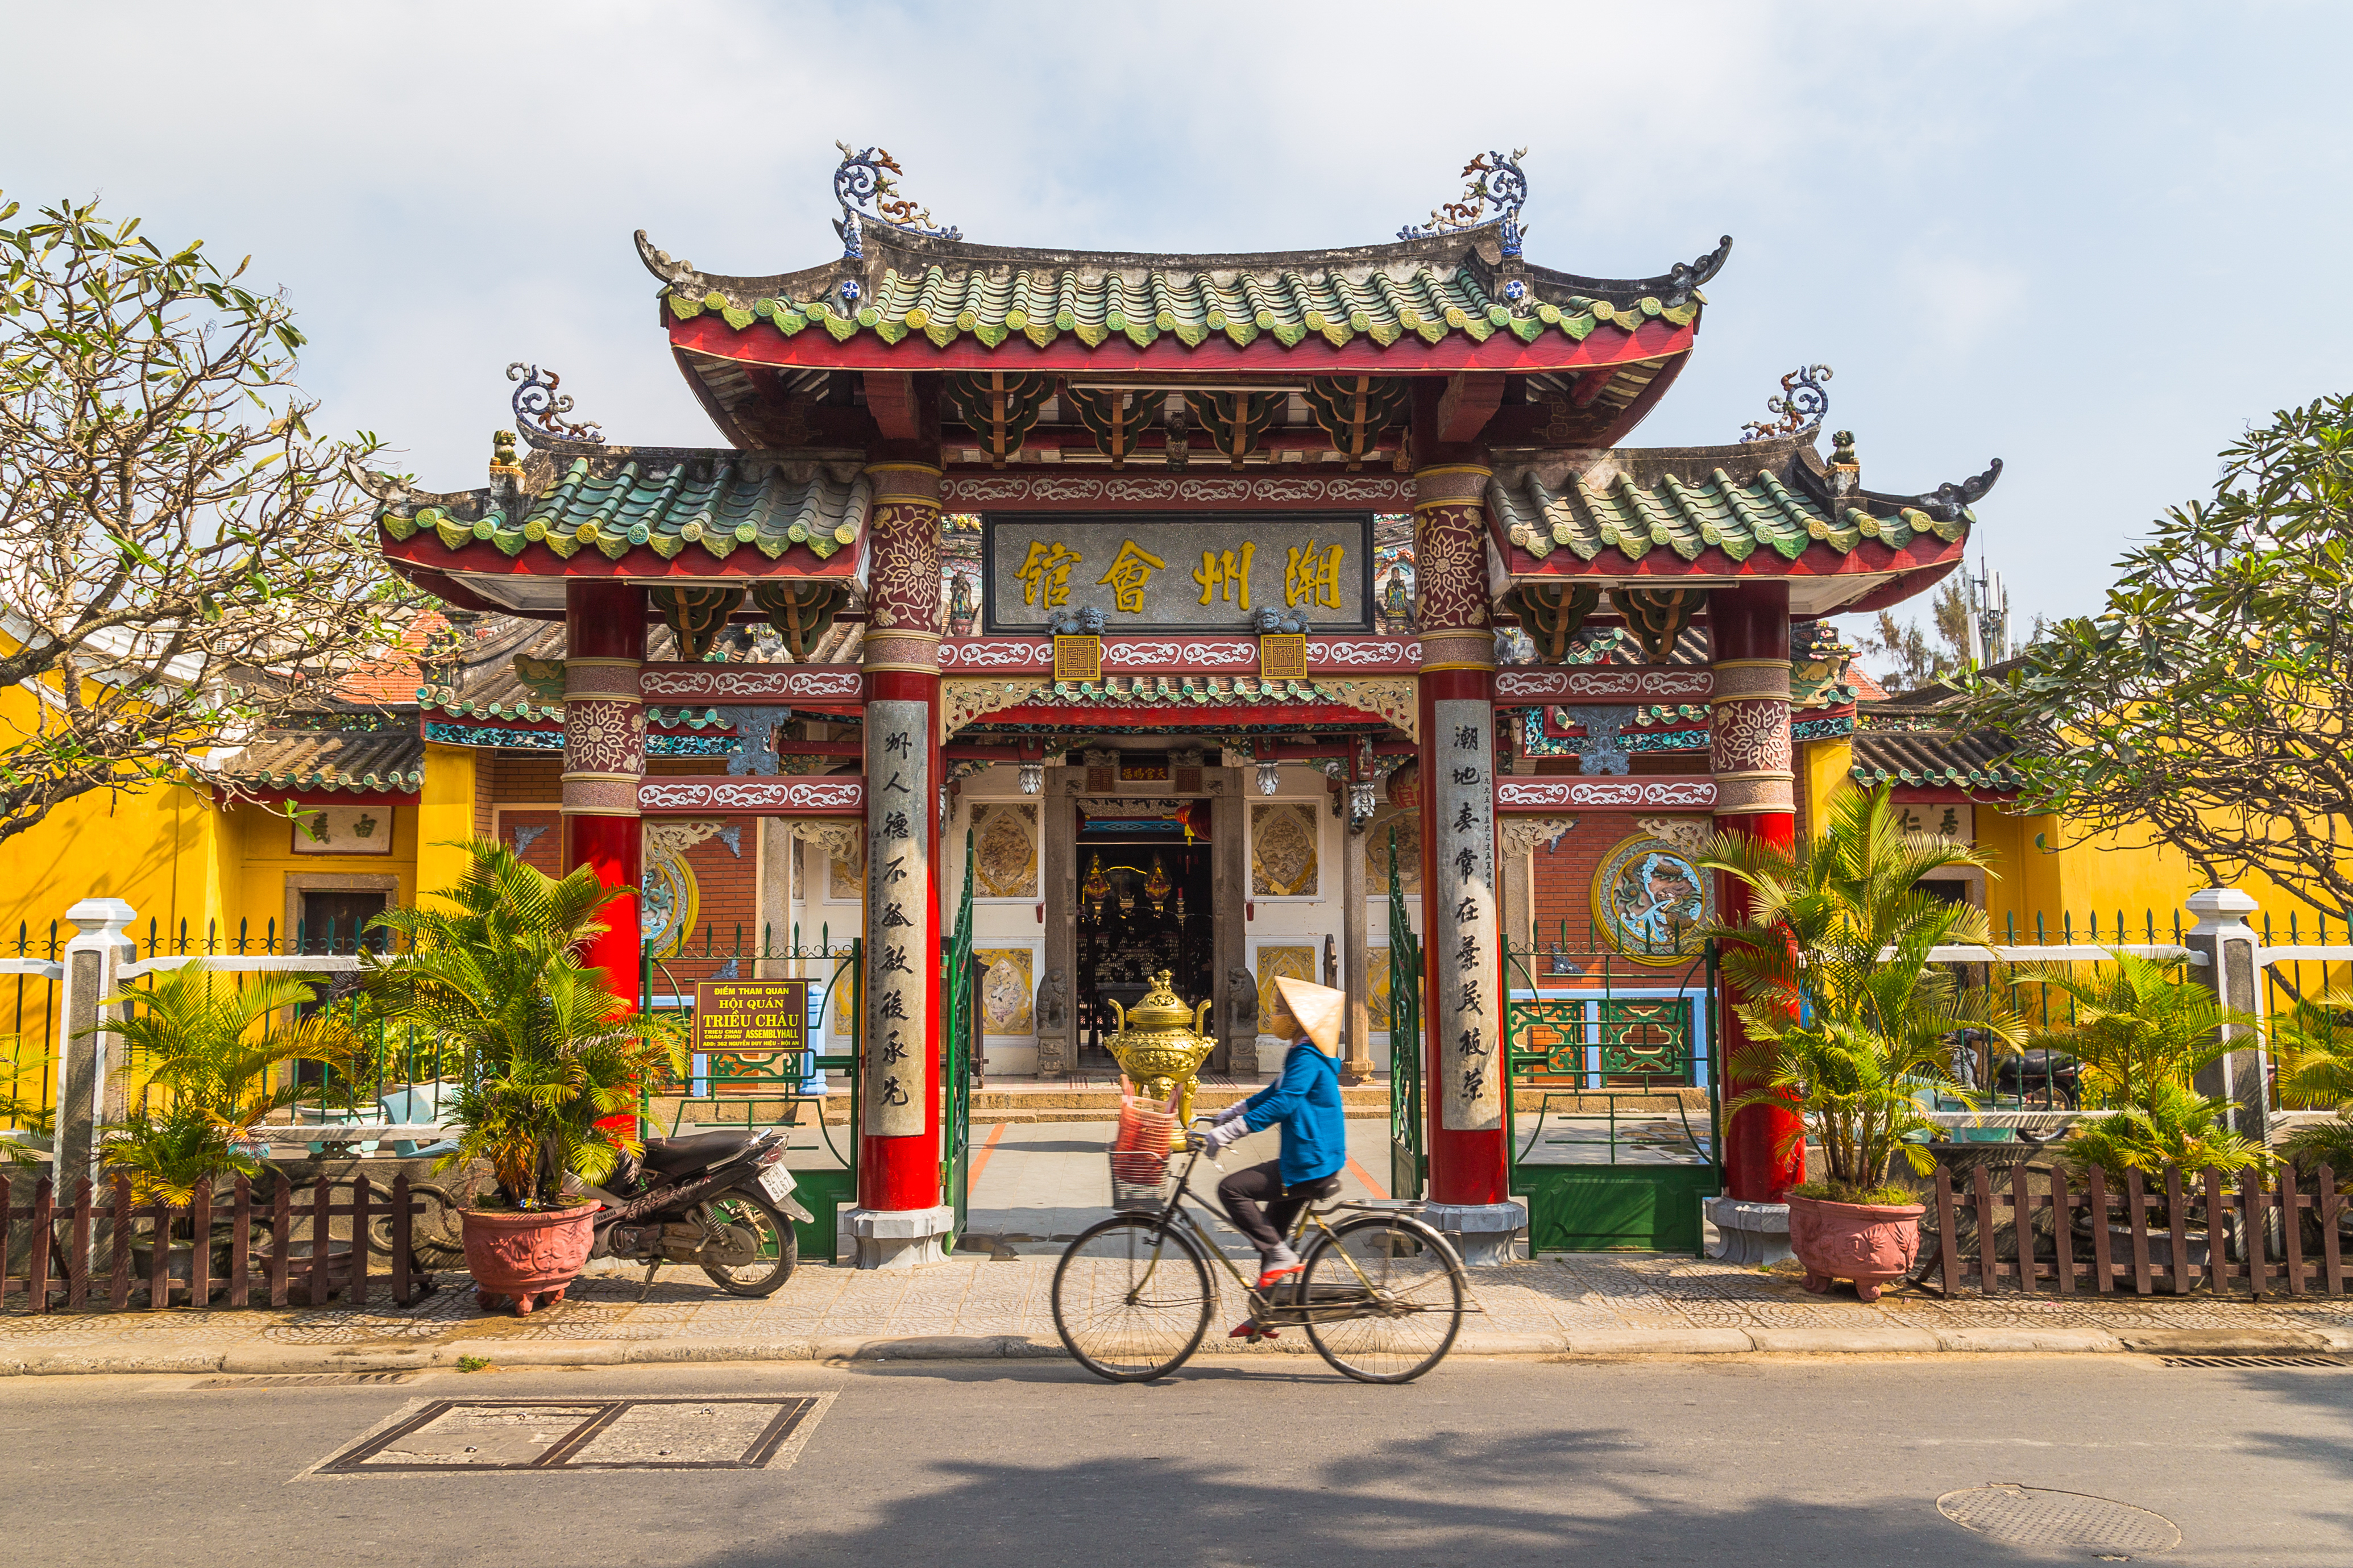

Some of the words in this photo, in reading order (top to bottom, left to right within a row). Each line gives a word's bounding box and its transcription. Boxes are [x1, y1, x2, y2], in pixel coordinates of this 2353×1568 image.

[719, 997, 744, 1010] HỘI
[746, 997, 784, 1010] QUÁN
[703, 1009, 752, 1028] TRIỀU
[755, 1010, 799, 1028] CHÂU
[771, 1176, 791, 1198] 9467
[596, 1210, 617, 1222] YAMAHA
